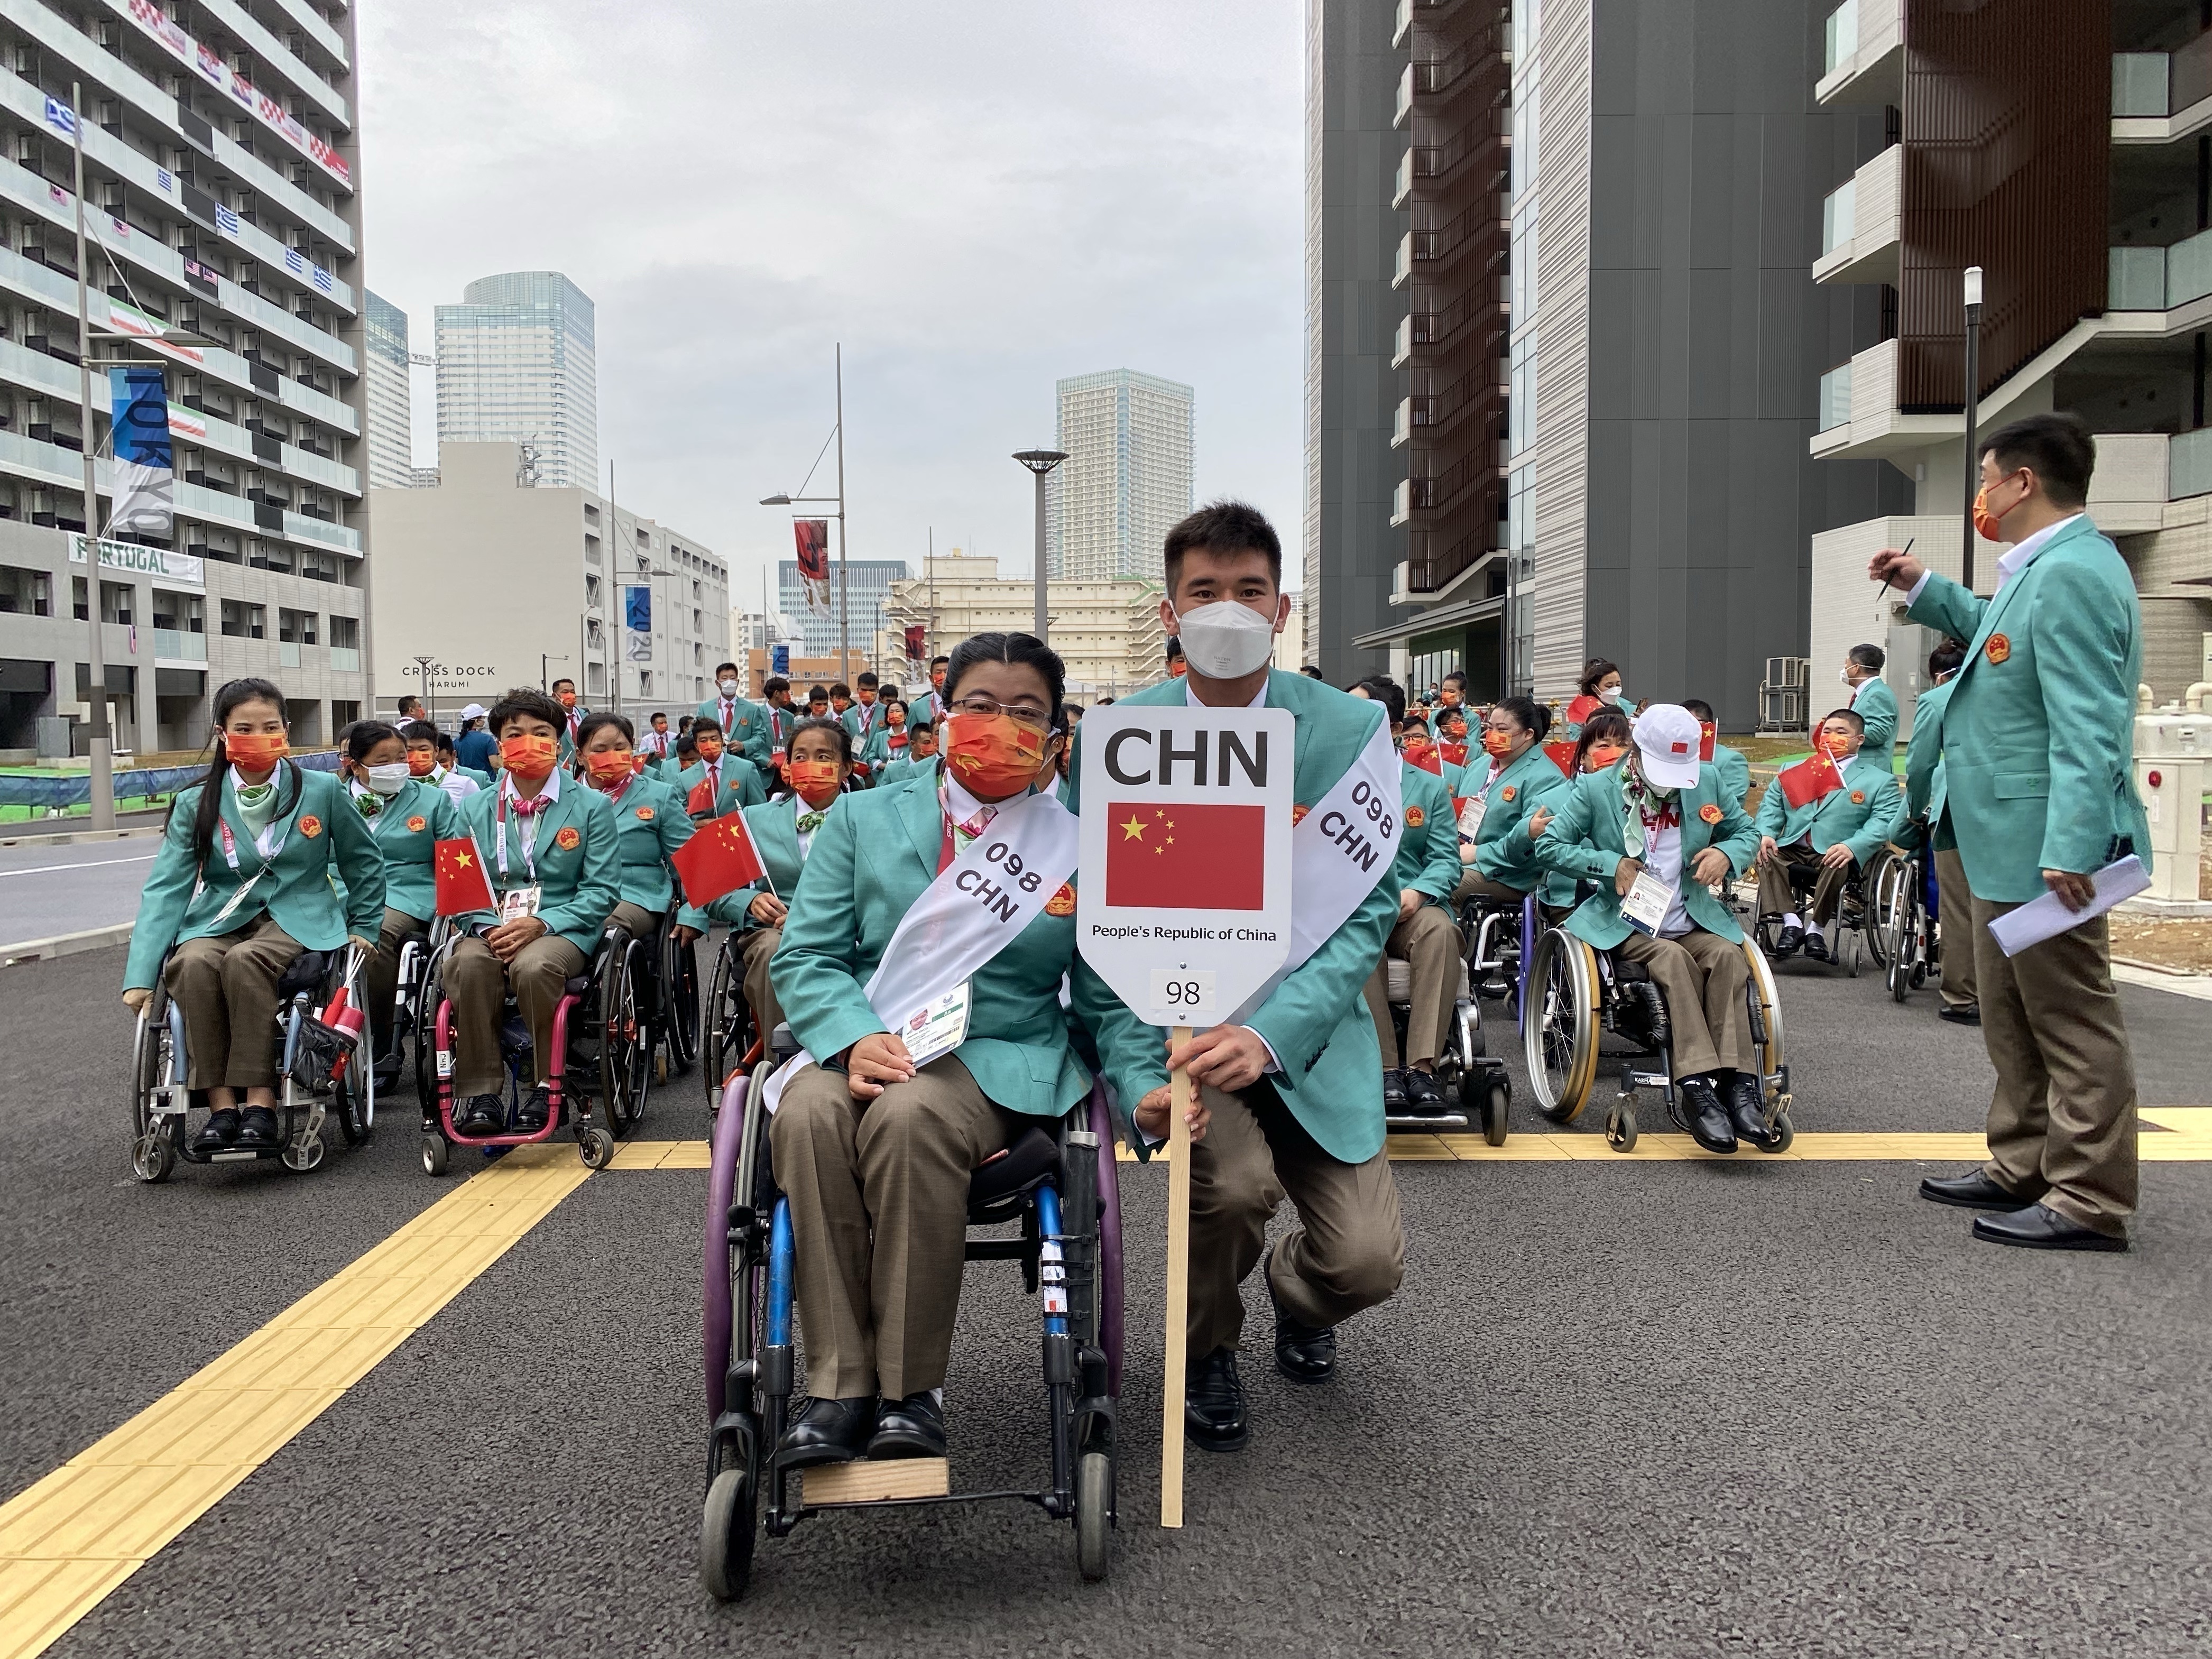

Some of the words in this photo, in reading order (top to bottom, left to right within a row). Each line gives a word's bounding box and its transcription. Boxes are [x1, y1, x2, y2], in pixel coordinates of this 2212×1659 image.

[336, 162, 348, 174] TEAM
[125, 375, 173, 536] TOKYO
[77, 537, 169, 574] PRTUGAL
[633, 606, 652, 661] 2020
[456, 667, 495, 676] DOCK
[778, 647, 789, 674] TOK
[1104, 728, 1268, 787] CHN
[1352, 781, 1393, 839] 098
[985, 842, 1042, 892] 098
[1320, 812, 1379, 873] CHN
[956, 870, 1020, 923] CHN
[1092, 925, 1150, 939] People's
[1155, 927, 1214, 941] Republic
[1218, 928, 1233, 939] of
[1237, 929, 1276, 941] China
[1166, 981, 1200, 1005] 98
